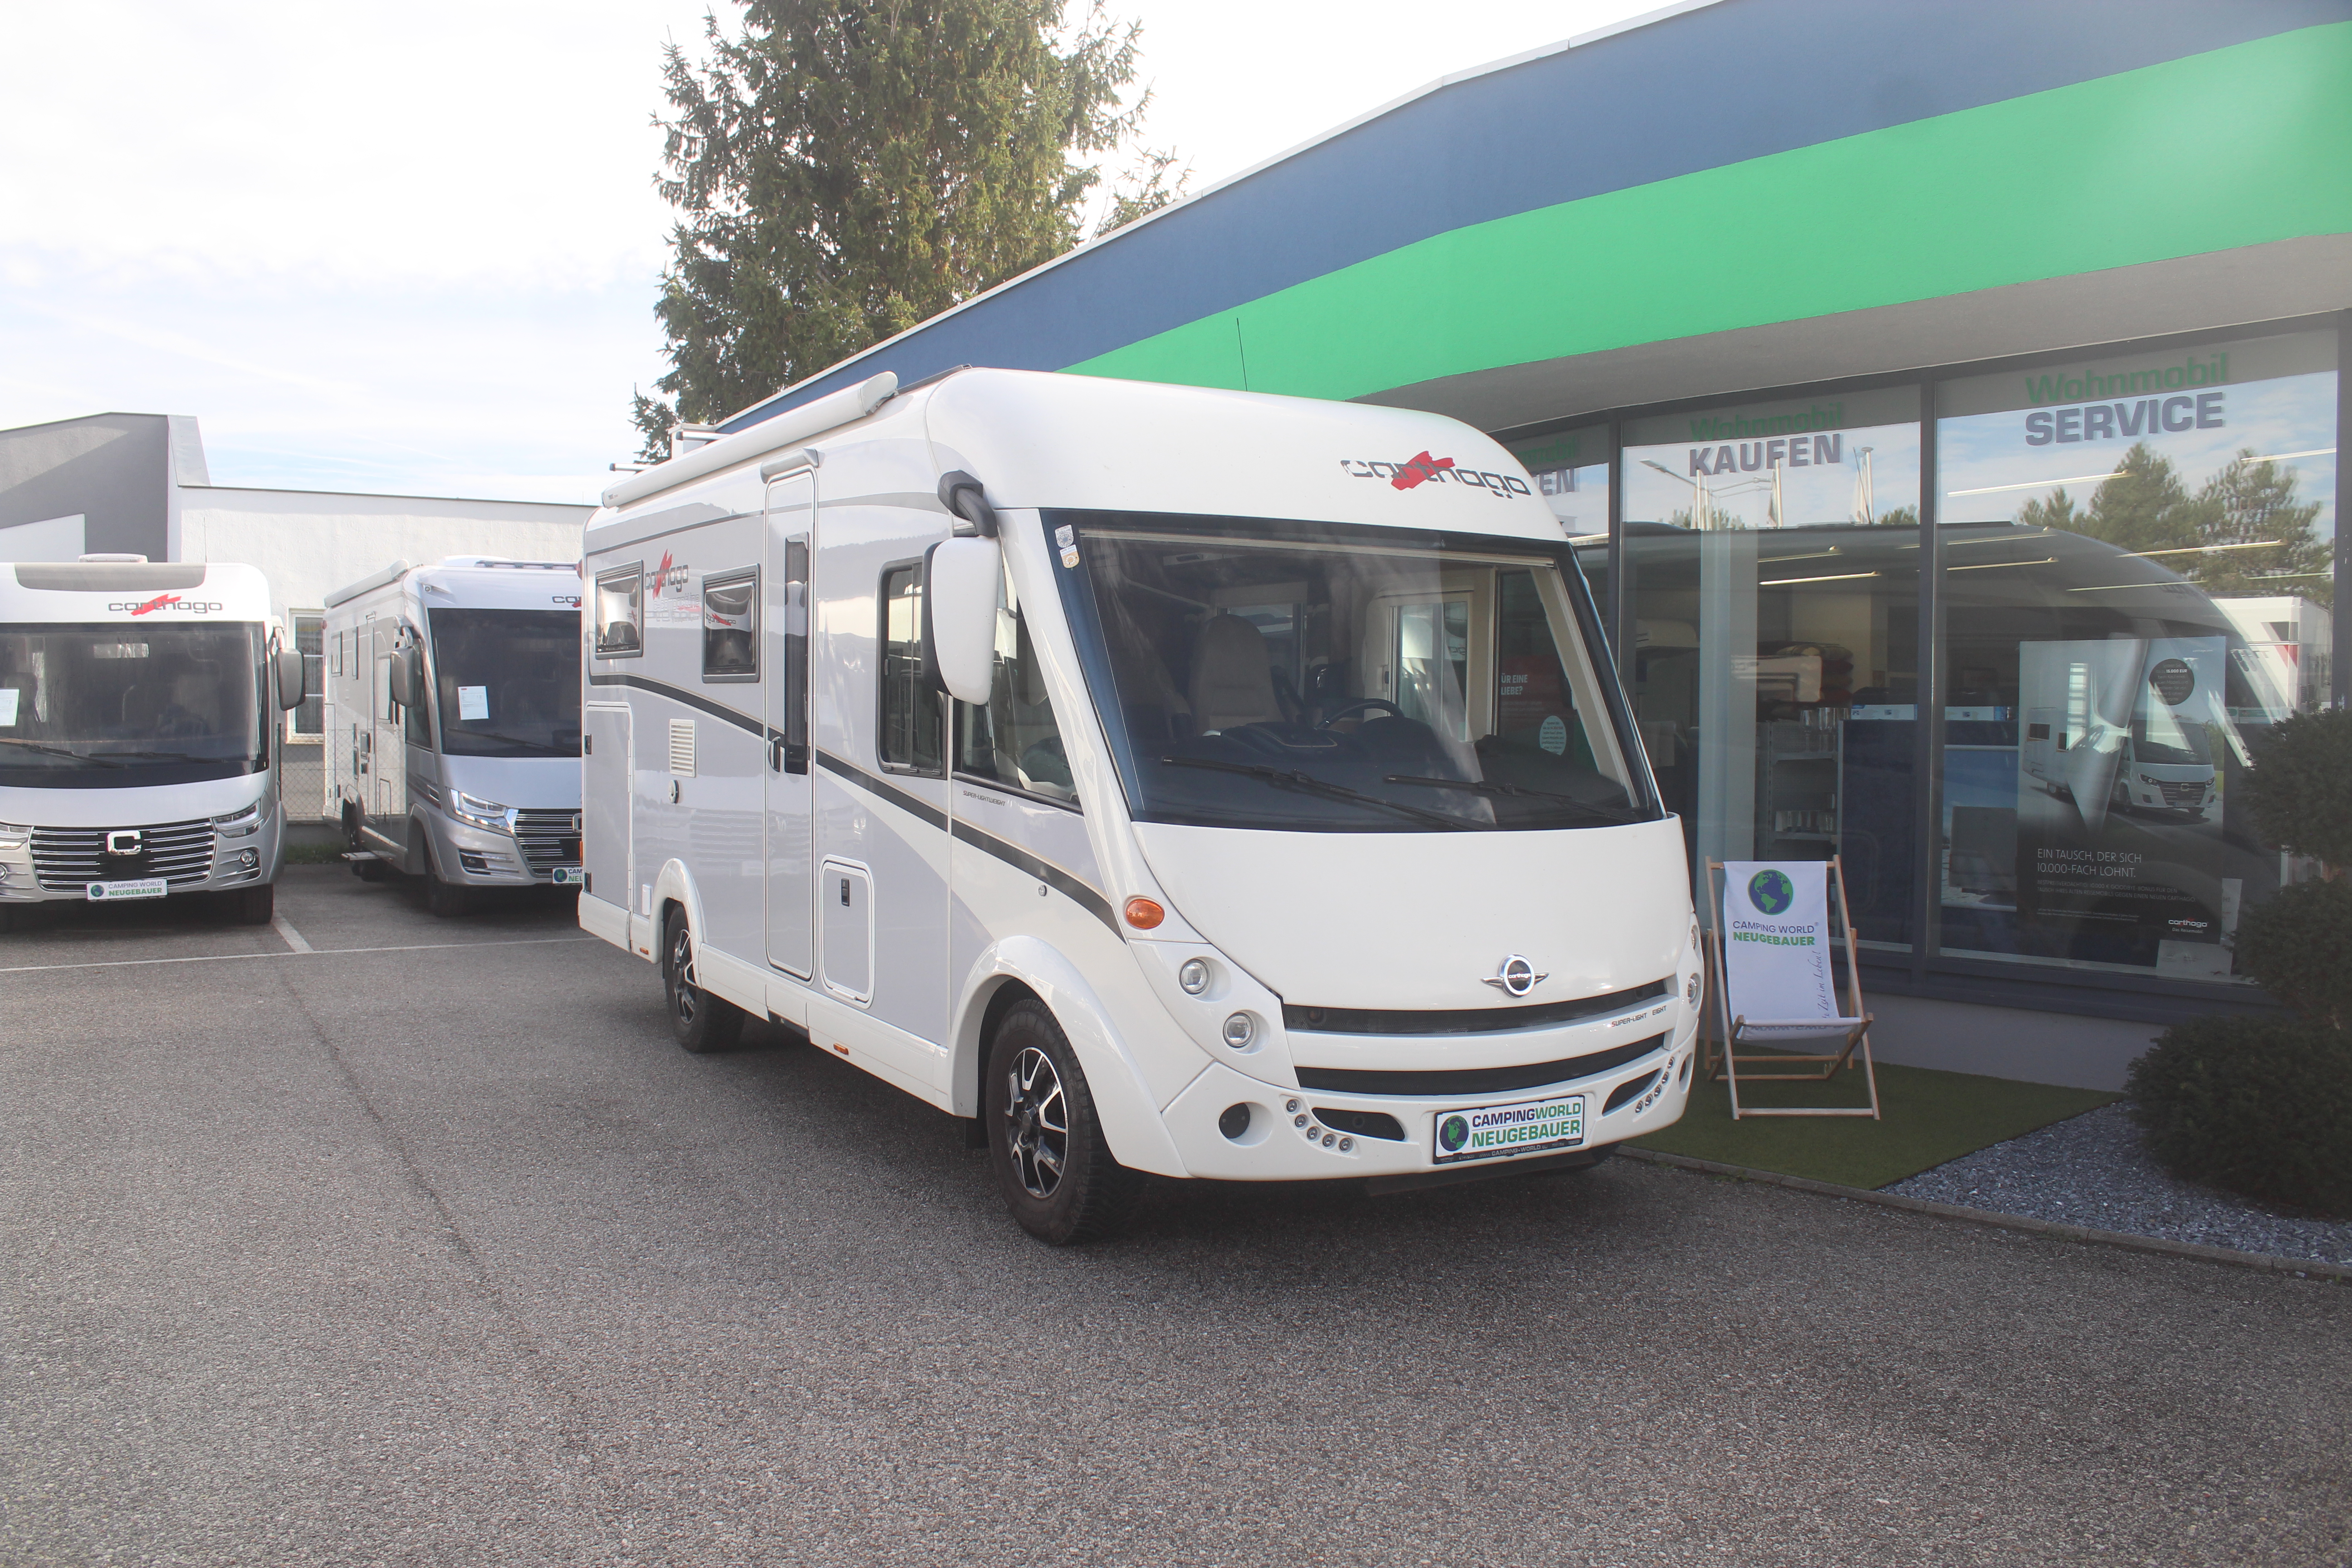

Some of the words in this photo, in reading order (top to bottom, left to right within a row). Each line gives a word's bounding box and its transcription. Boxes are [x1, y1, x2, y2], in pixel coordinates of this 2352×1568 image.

[2025, 352, 2227, 403] Wohnmobil
[1690, 402, 1842, 441] Wohnmobil
[2025, 392, 2225, 446] SERVICE
[1689, 433, 1841, 477] KAUFEN
[1340, 460, 1532, 499] carthago
[644, 564, 689, 593] carthago
[108, 600, 223, 614] carthago
[1512, 675, 1528, 683] EINE
[1501, 686, 1523, 695] LIEBE?
[963, 790, 1006, 806] SUPER-LIGHTWEIGHT
[2038, 848, 2053, 858] EIN
[2055, 849, 2093, 862] TAUSCH,
[2097, 852, 2116, 862] DER
[2119, 853, 2141, 863] SICH
[2037, 862, 2096, 875] 10.000-FACH
[2100, 866, 2136, 878] LOHNT.
[108, 887, 162, 897] NEUGEBAUER
[1733, 921, 1776, 933] CAMPING
[1778, 925, 1814, 933] WORLD
[2168, 919, 2207, 928] carthago
[1733, 931, 1815, 946] NEUGEBAUER
[1472, 1119, 1581, 1148] NEUGEBAUER
